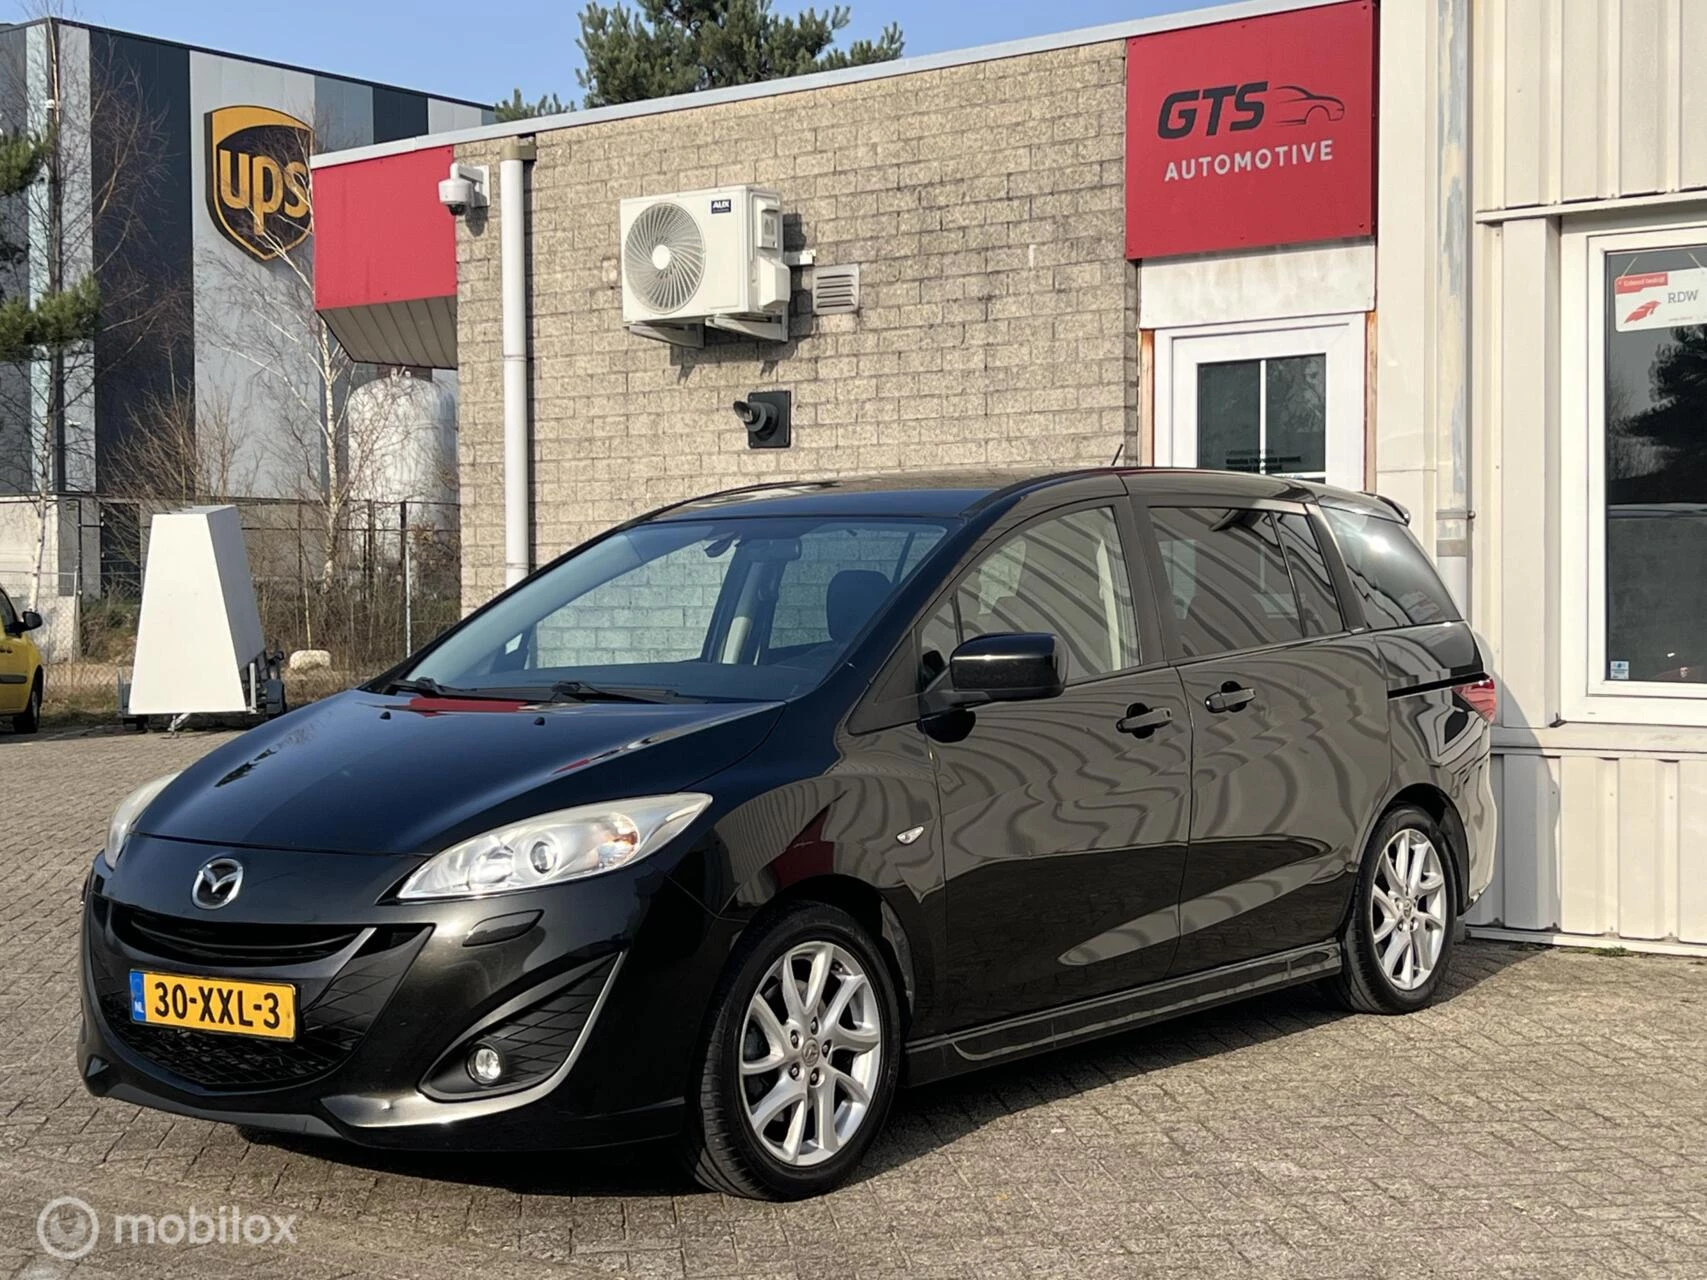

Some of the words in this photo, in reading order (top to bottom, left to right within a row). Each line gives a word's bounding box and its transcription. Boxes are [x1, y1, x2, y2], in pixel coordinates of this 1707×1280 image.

[1157, 81, 1268, 139] GTS
[1164, 140, 1333, 182] AUTOMOTIVE
[1667, 290, 1699, 304] RDW
[155, 981, 280, 1029] 30-XXL-3
